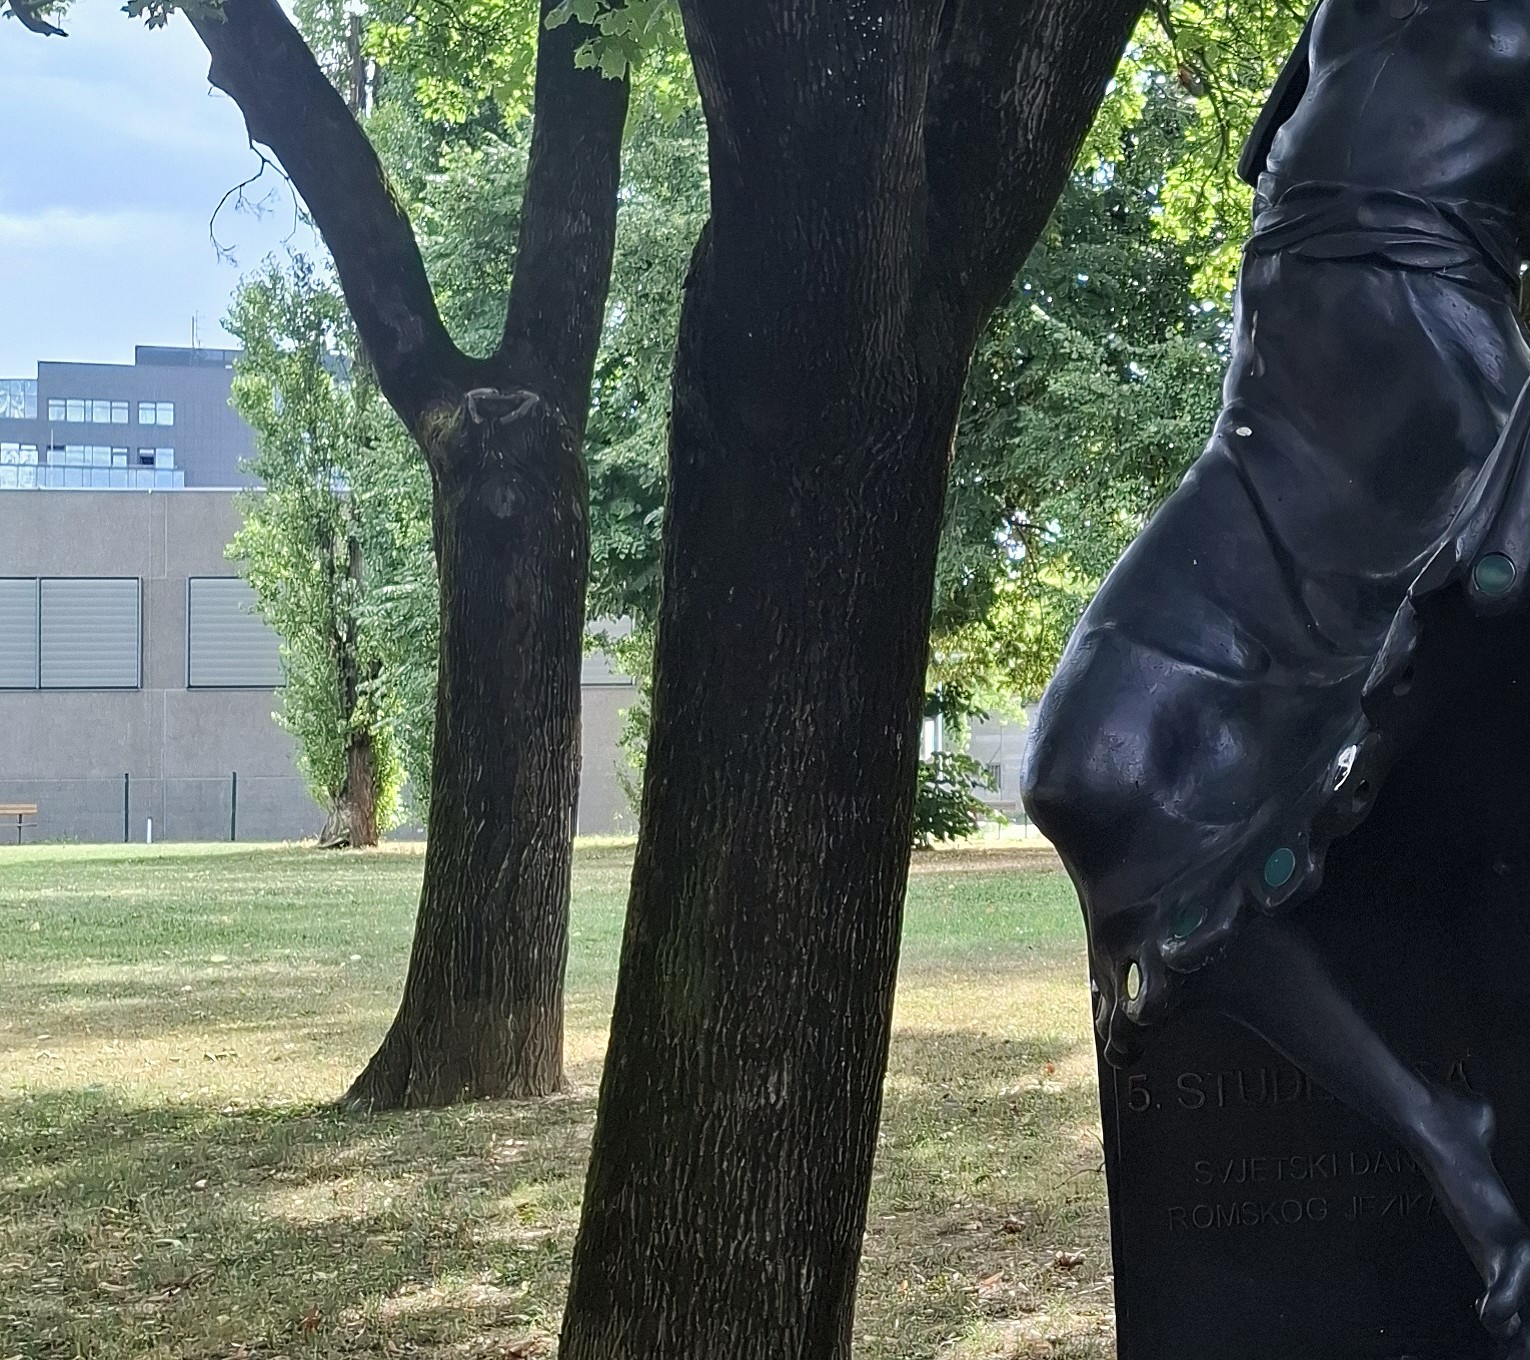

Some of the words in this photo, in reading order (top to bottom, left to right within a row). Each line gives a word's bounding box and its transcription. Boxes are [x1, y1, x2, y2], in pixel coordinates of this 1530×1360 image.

[1126, 1073, 1162, 1112] 5.
[1193, 1153, 1338, 1185] SVJETSKI
[1168, 1196, 1328, 1231] ROMSKOG
